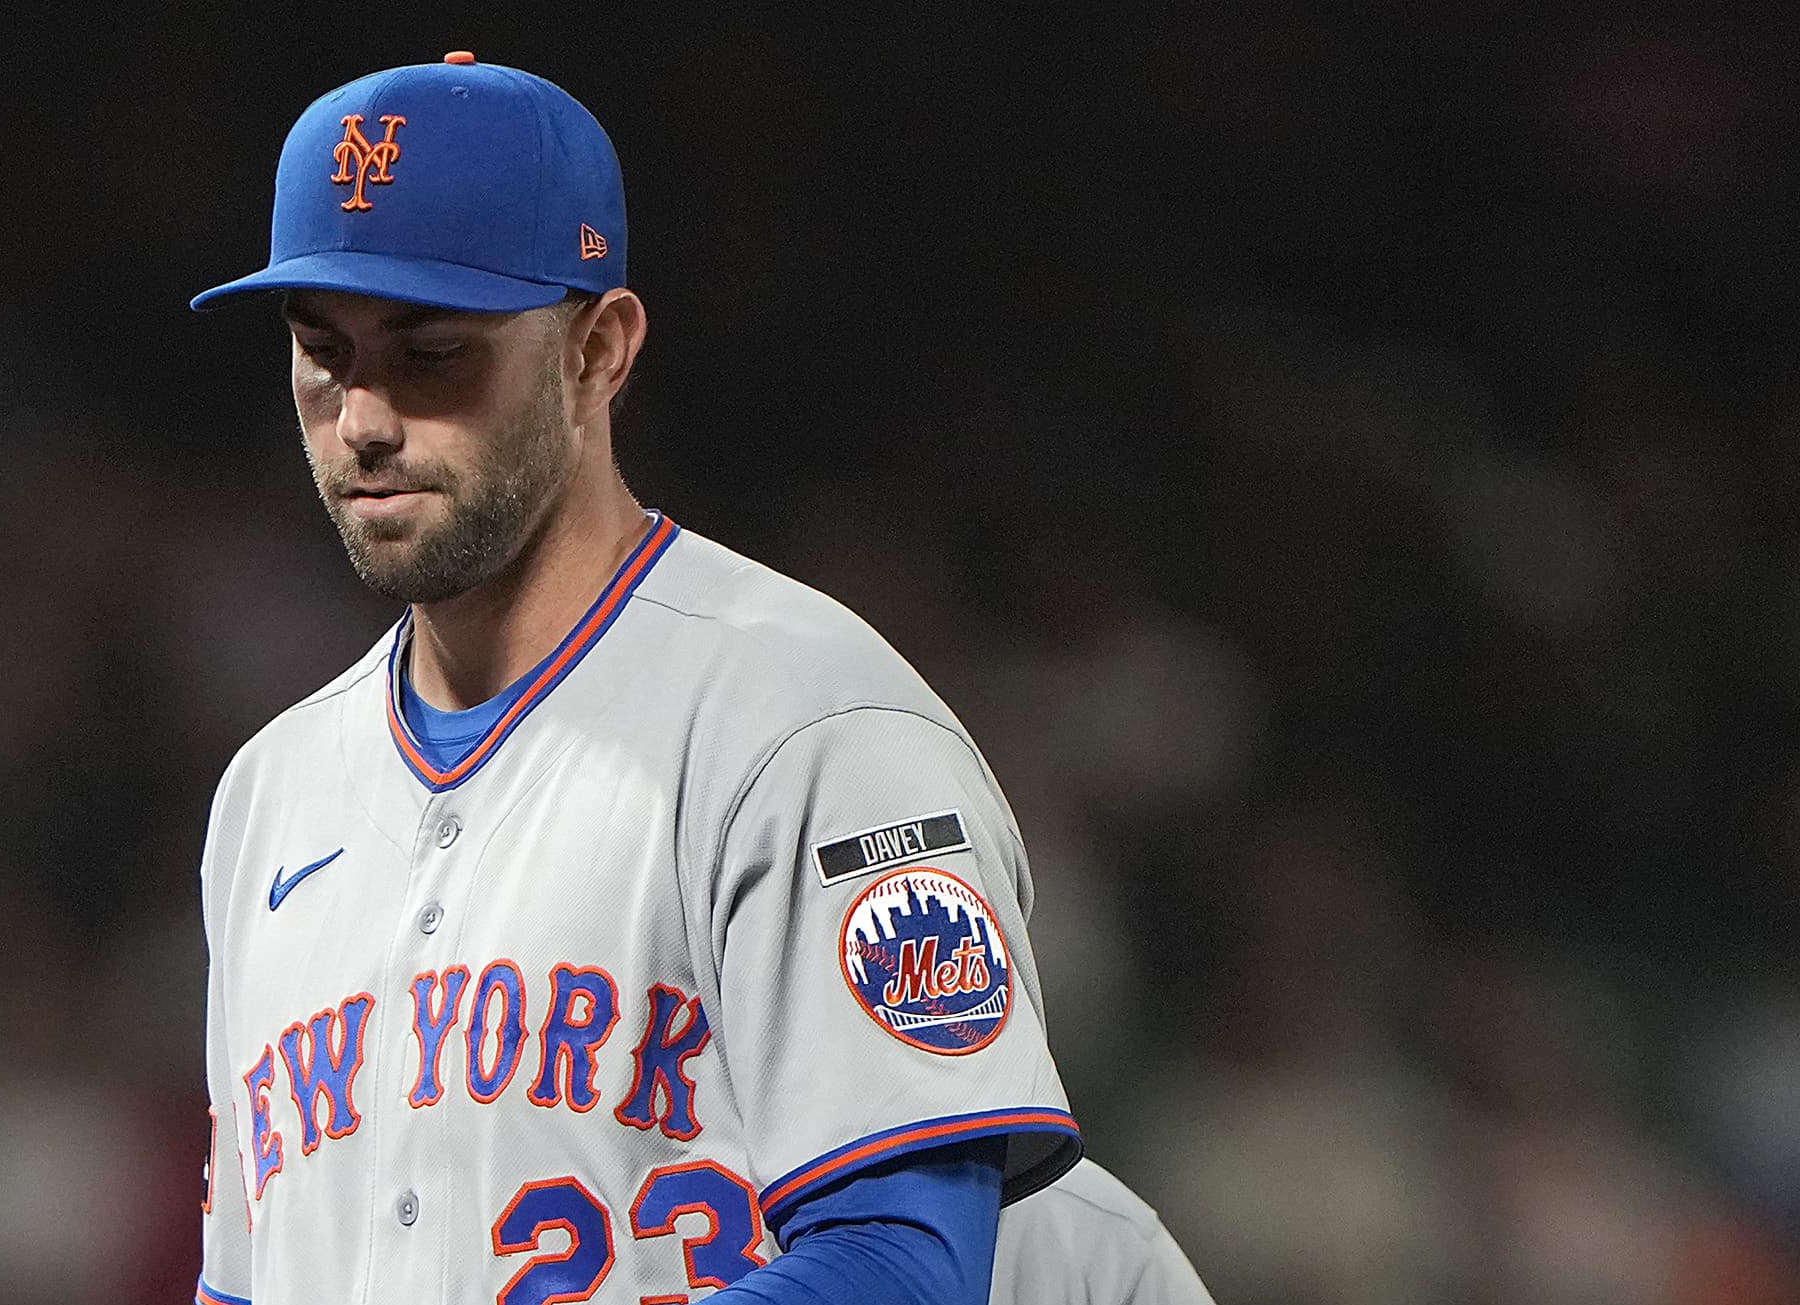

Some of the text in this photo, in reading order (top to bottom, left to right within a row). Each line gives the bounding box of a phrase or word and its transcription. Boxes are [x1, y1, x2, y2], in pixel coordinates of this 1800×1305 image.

[858, 821, 928, 867] DAVEY
[883, 935, 990, 1007] Mets
[242, 957, 713, 1201] EW YORK
